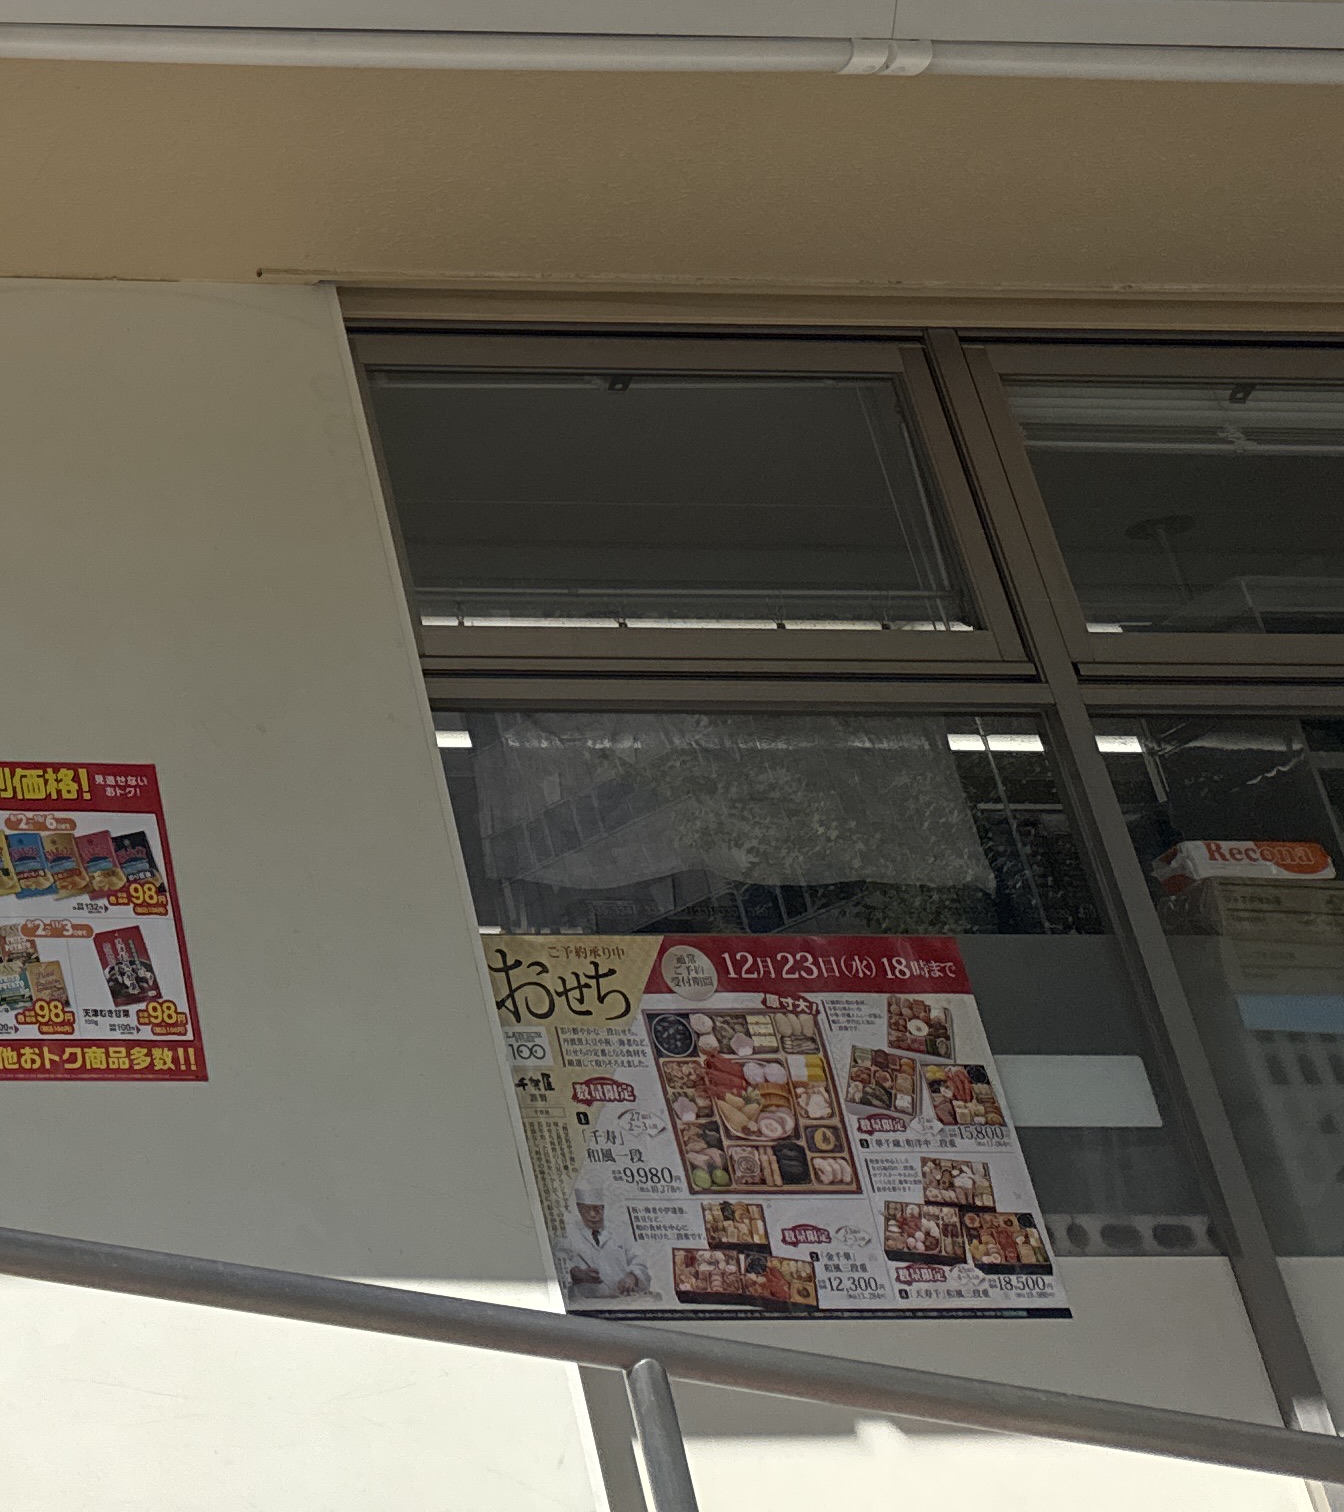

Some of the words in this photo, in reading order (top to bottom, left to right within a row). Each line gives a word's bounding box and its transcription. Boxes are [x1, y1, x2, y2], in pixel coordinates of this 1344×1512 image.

[94, 774, 148, 787] 見逃せない
[1203, 841, 1315, 865] Recona
[547, 945, 626, 961] ご予約承り中
[674, 966, 705, 976] ご予約
[881, 956, 957, 981] 18時まで
[488, 948, 631, 1024] おせち
[83, 1009, 130, 1018] 天津むき甘栗
[587, 1148, 644, 1163] 和風一段
